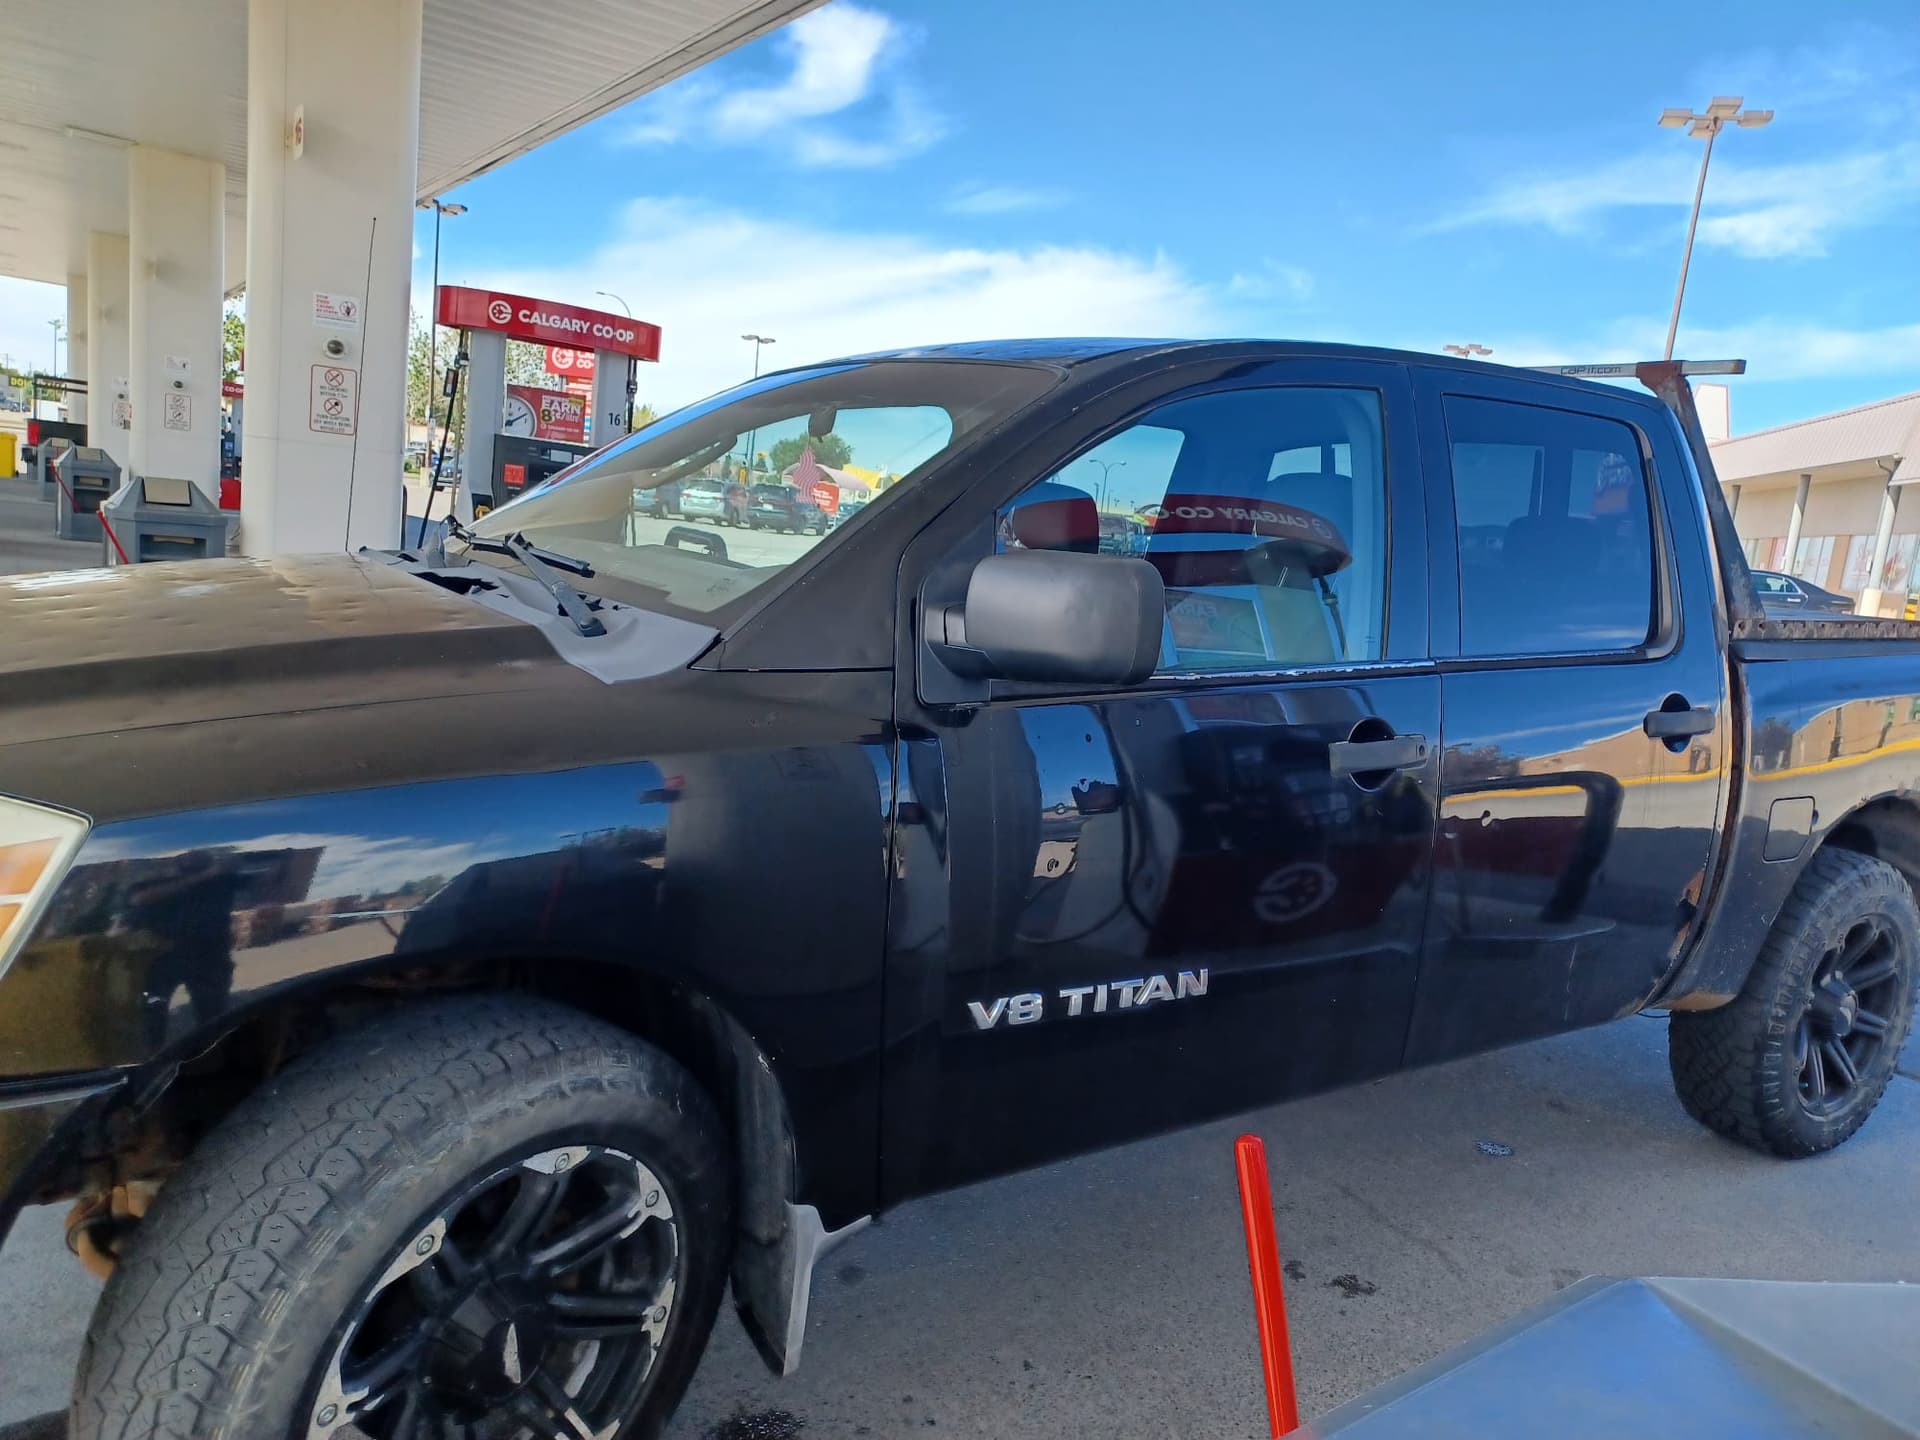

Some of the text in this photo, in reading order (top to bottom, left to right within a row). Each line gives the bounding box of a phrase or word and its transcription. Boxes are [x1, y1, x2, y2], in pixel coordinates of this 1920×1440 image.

[518, 309, 634, 343] CALGARY CO-OP
[542, 398, 581, 415] EARN
[608, 412, 621, 426] 16
[967, 968, 1209, 1030] V8 TITAN
